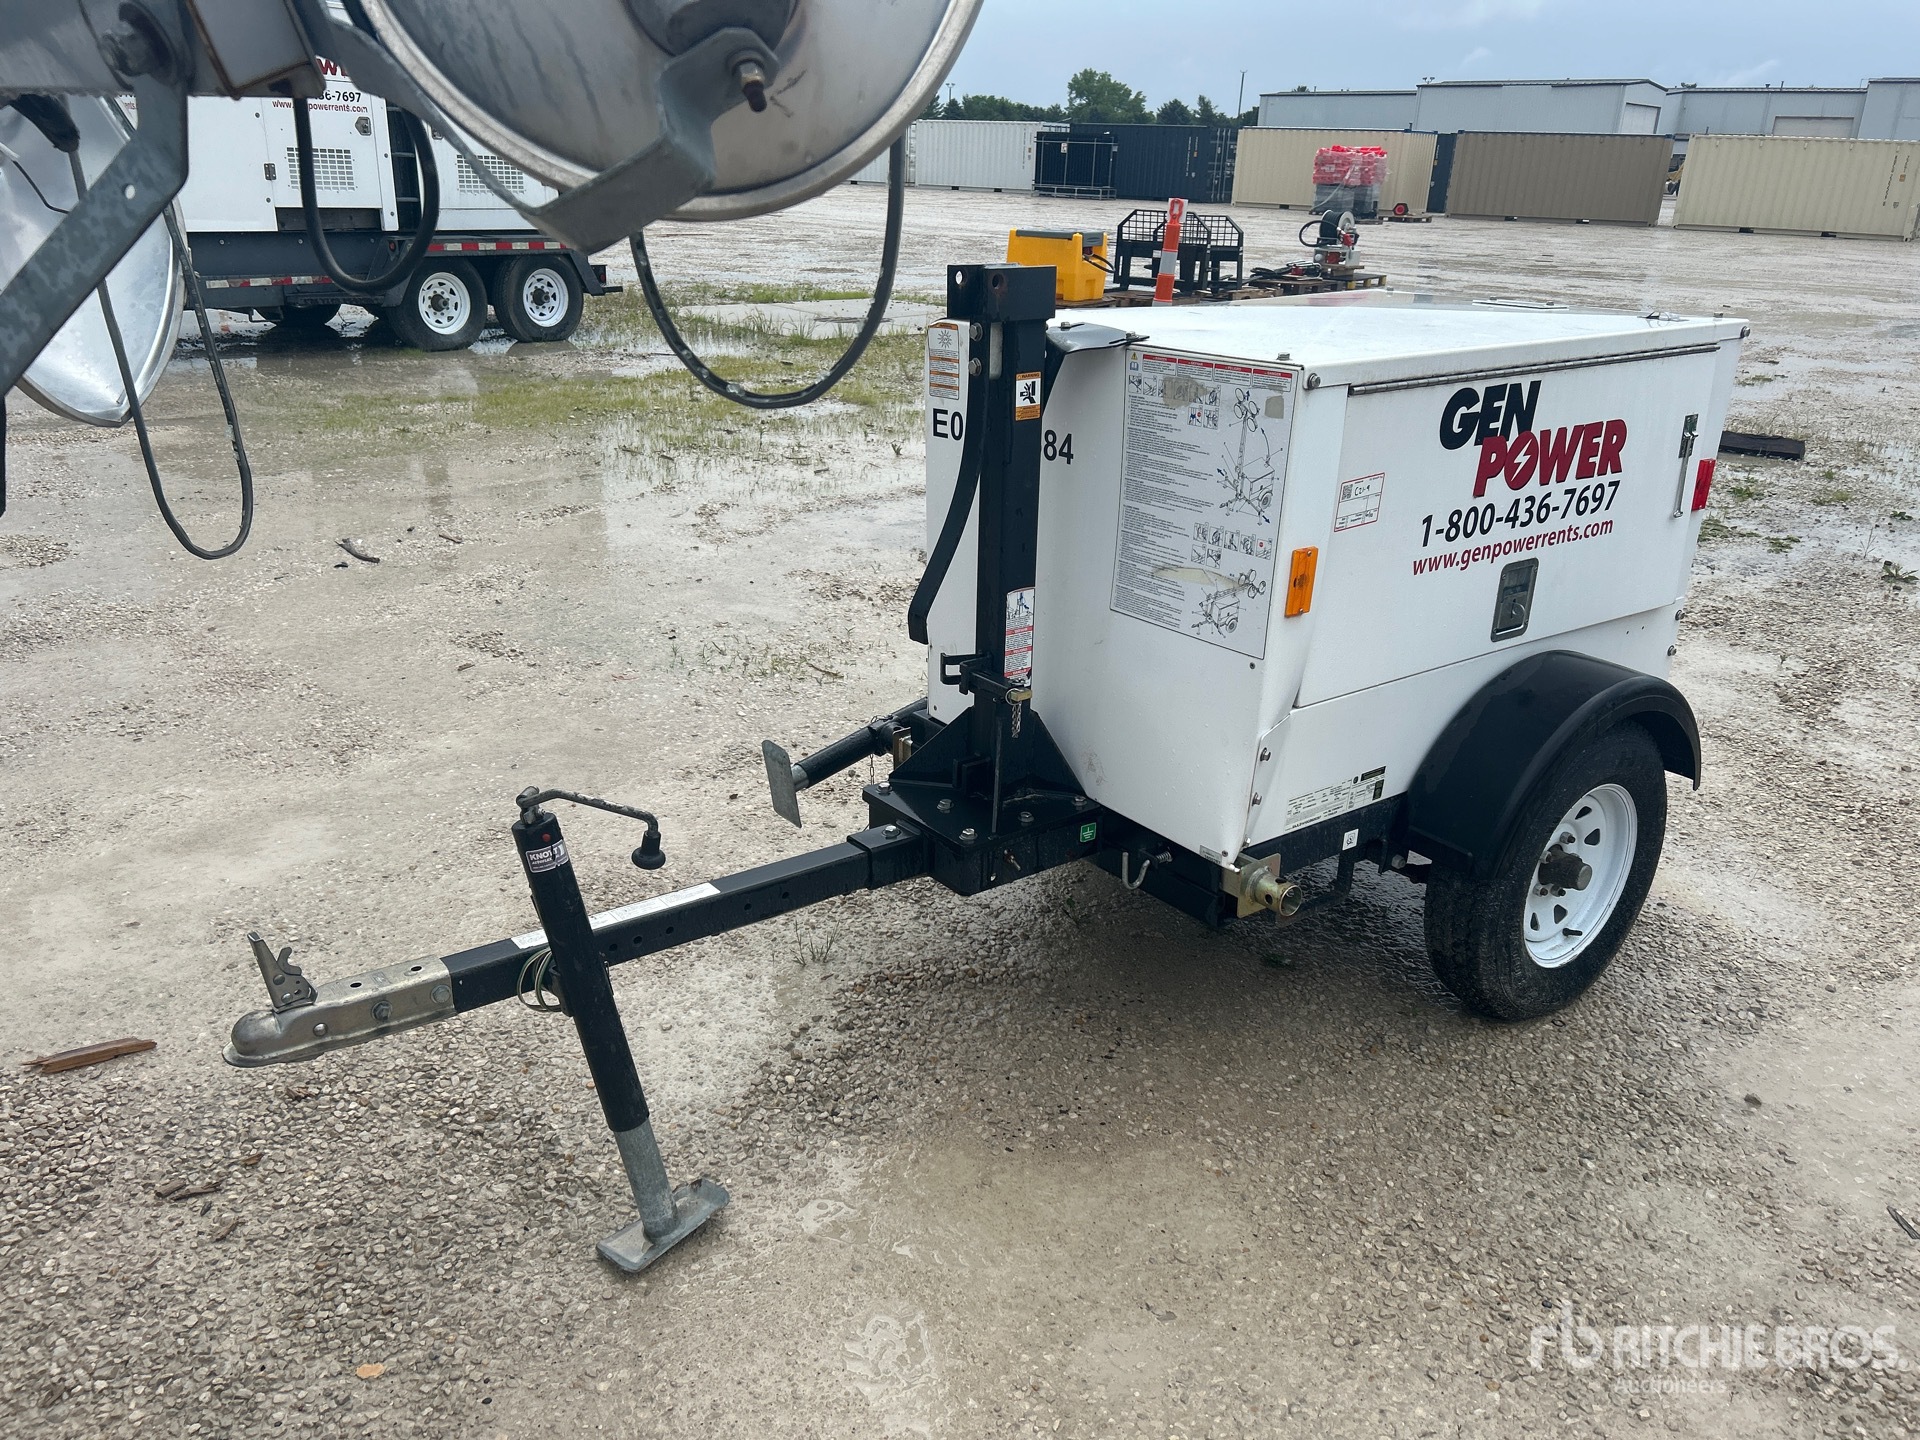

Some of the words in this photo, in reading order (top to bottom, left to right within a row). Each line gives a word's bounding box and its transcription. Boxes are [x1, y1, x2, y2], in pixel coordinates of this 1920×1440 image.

[1439, 380, 1542, 450] GEN
[1472, 419, 1627, 498] POWER
[1412, 517, 1614, 577] www.genpowerrents.com
[1422, 480, 1621, 547] 1-800-436-7697
